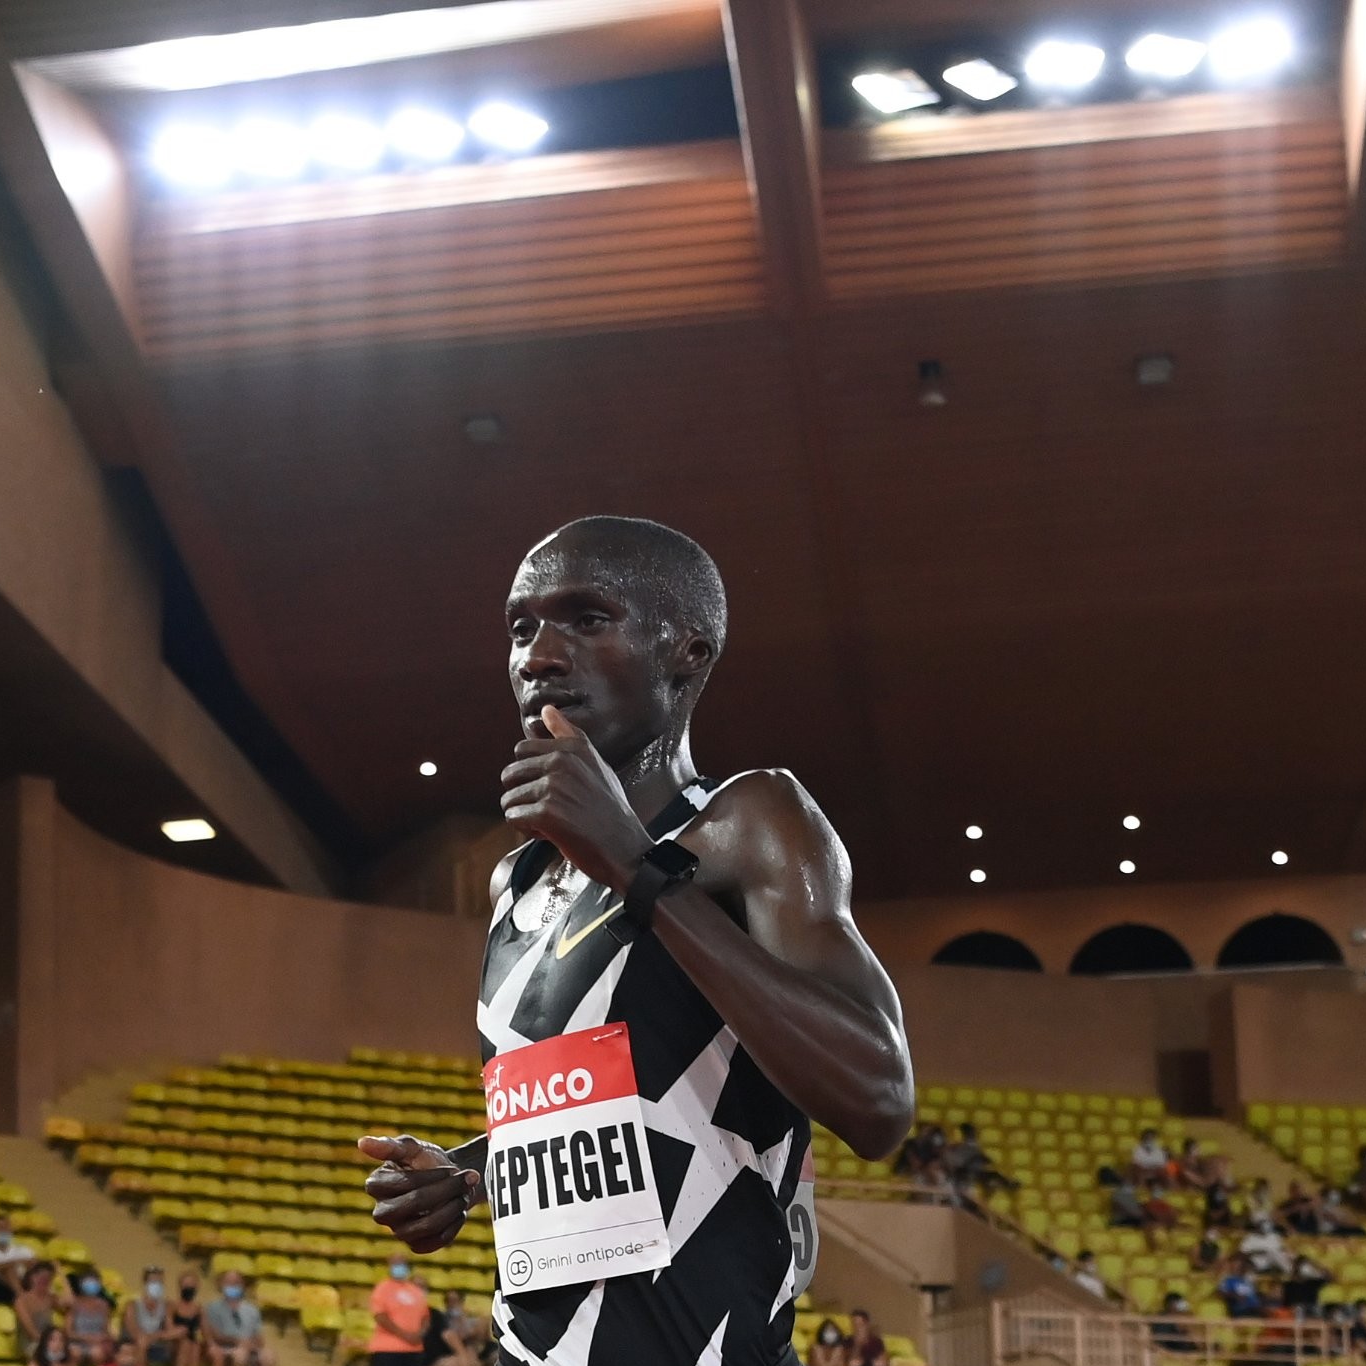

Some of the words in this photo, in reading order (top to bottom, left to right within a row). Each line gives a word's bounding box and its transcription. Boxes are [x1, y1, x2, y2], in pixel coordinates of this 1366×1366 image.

[486, 1121, 646, 1221] EPTEGEI
[537, 1252, 572, 1270] Ginini
[576, 1242, 644, 1264] antipode
